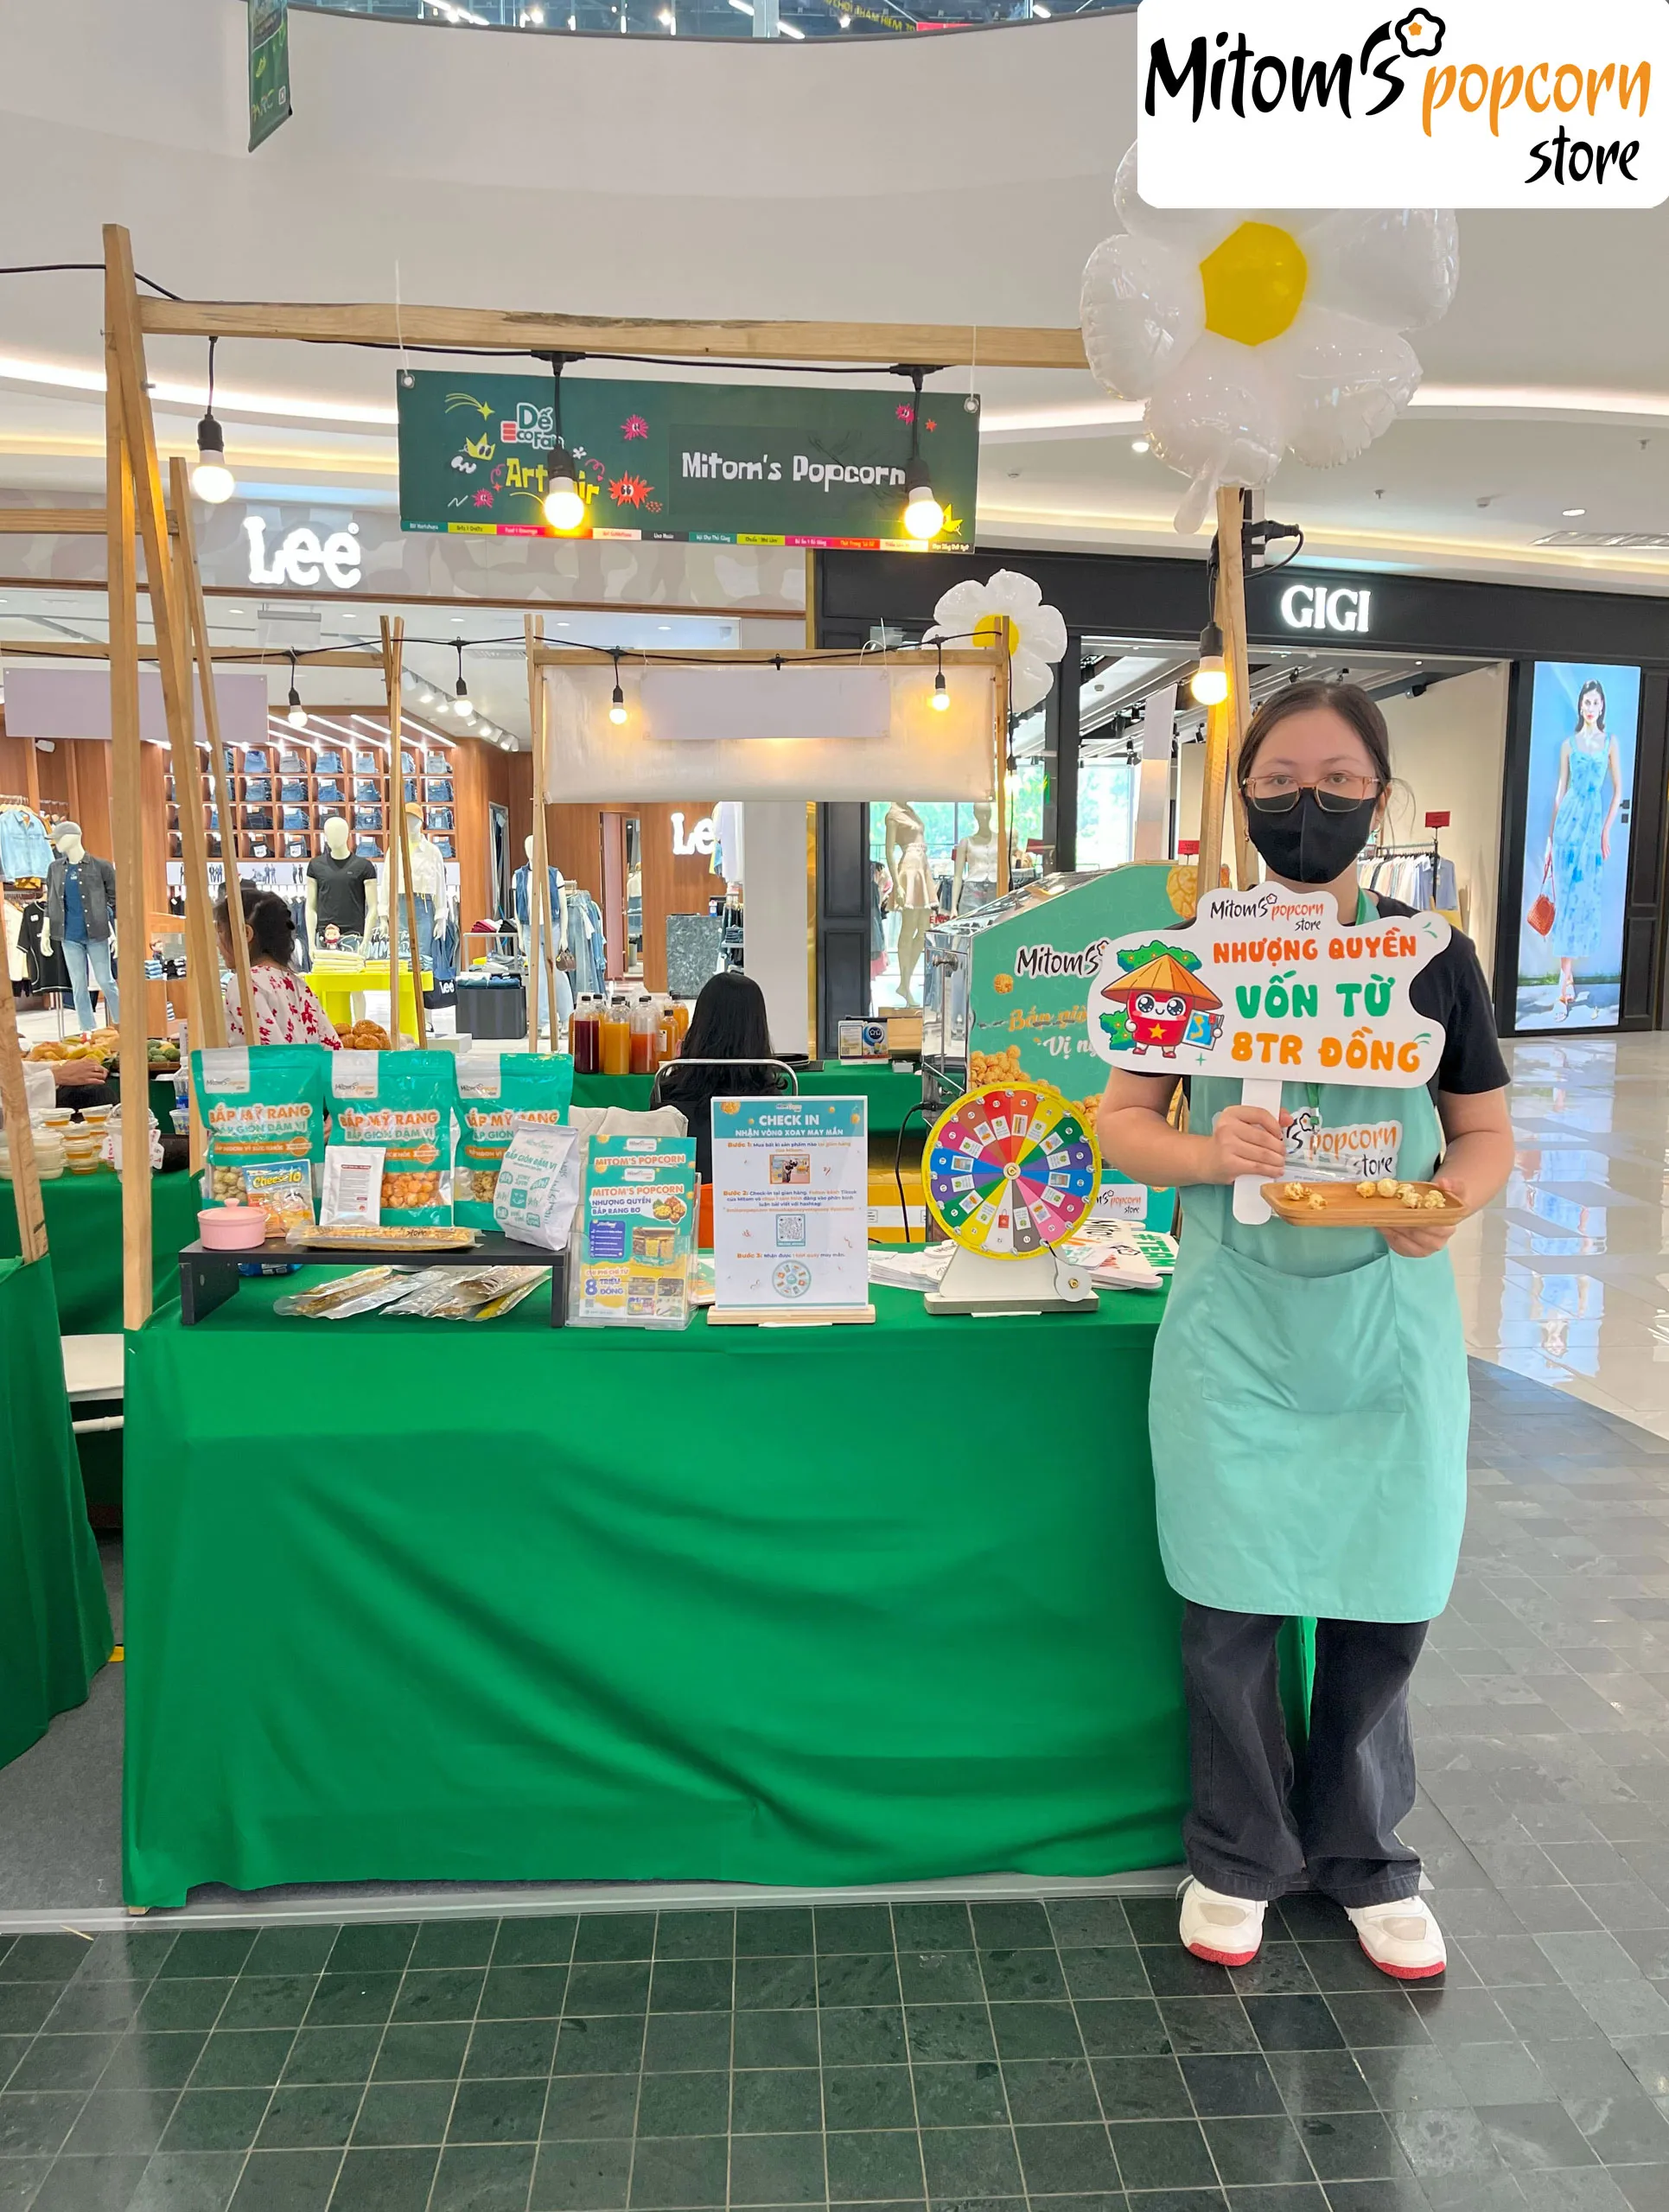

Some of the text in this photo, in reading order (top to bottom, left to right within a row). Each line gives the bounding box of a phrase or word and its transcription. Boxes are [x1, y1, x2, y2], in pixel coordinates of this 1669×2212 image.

[506, 457, 548, 492] Art
[682, 452, 906, 492] Mitom's Popcorn
[243, 516, 361, 589] Lee
[1281, 584, 1372, 633] GIGI
[671, 813, 715, 855] Le
[1210, 896, 1324, 921] Mitom's popcorn
[1295, 917, 1322, 932] store
[1213, 927, 1417, 966] NHƯỢNG QUYỀN
[1016, 943, 1099, 976] Mitom's
[1235, 970, 1396, 1018] VỐN TỪ
[1057, 1004, 1088, 1029] giò
[1231, 1026, 1420, 1073] 8TR ĐỒNG
[266, 1105, 310, 1119] RANG
[339, 1110, 364, 1127] BẮP
[395, 1112, 438, 1125] RANG
[490, 1112, 513, 1126] MỸ
[759, 1114, 820, 1126] CHECK IN
[735, 1128, 760, 1138] NHẬN
[761, 1128, 783, 1137] VÒNG
[825, 1127, 844, 1136] MẮN
[1309, 1125, 1398, 1162] popcorn
[595, 1155, 685, 1166] MITOM'S POPCORN
[1354, 1153, 1393, 1177] store
[592, 1185, 684, 1196] MITOM'S POPCORN
[1110, 1195, 1142, 1208] popcorn
[1124, 1204, 1140, 1214] store
[585, 1279, 598, 1296] 8
